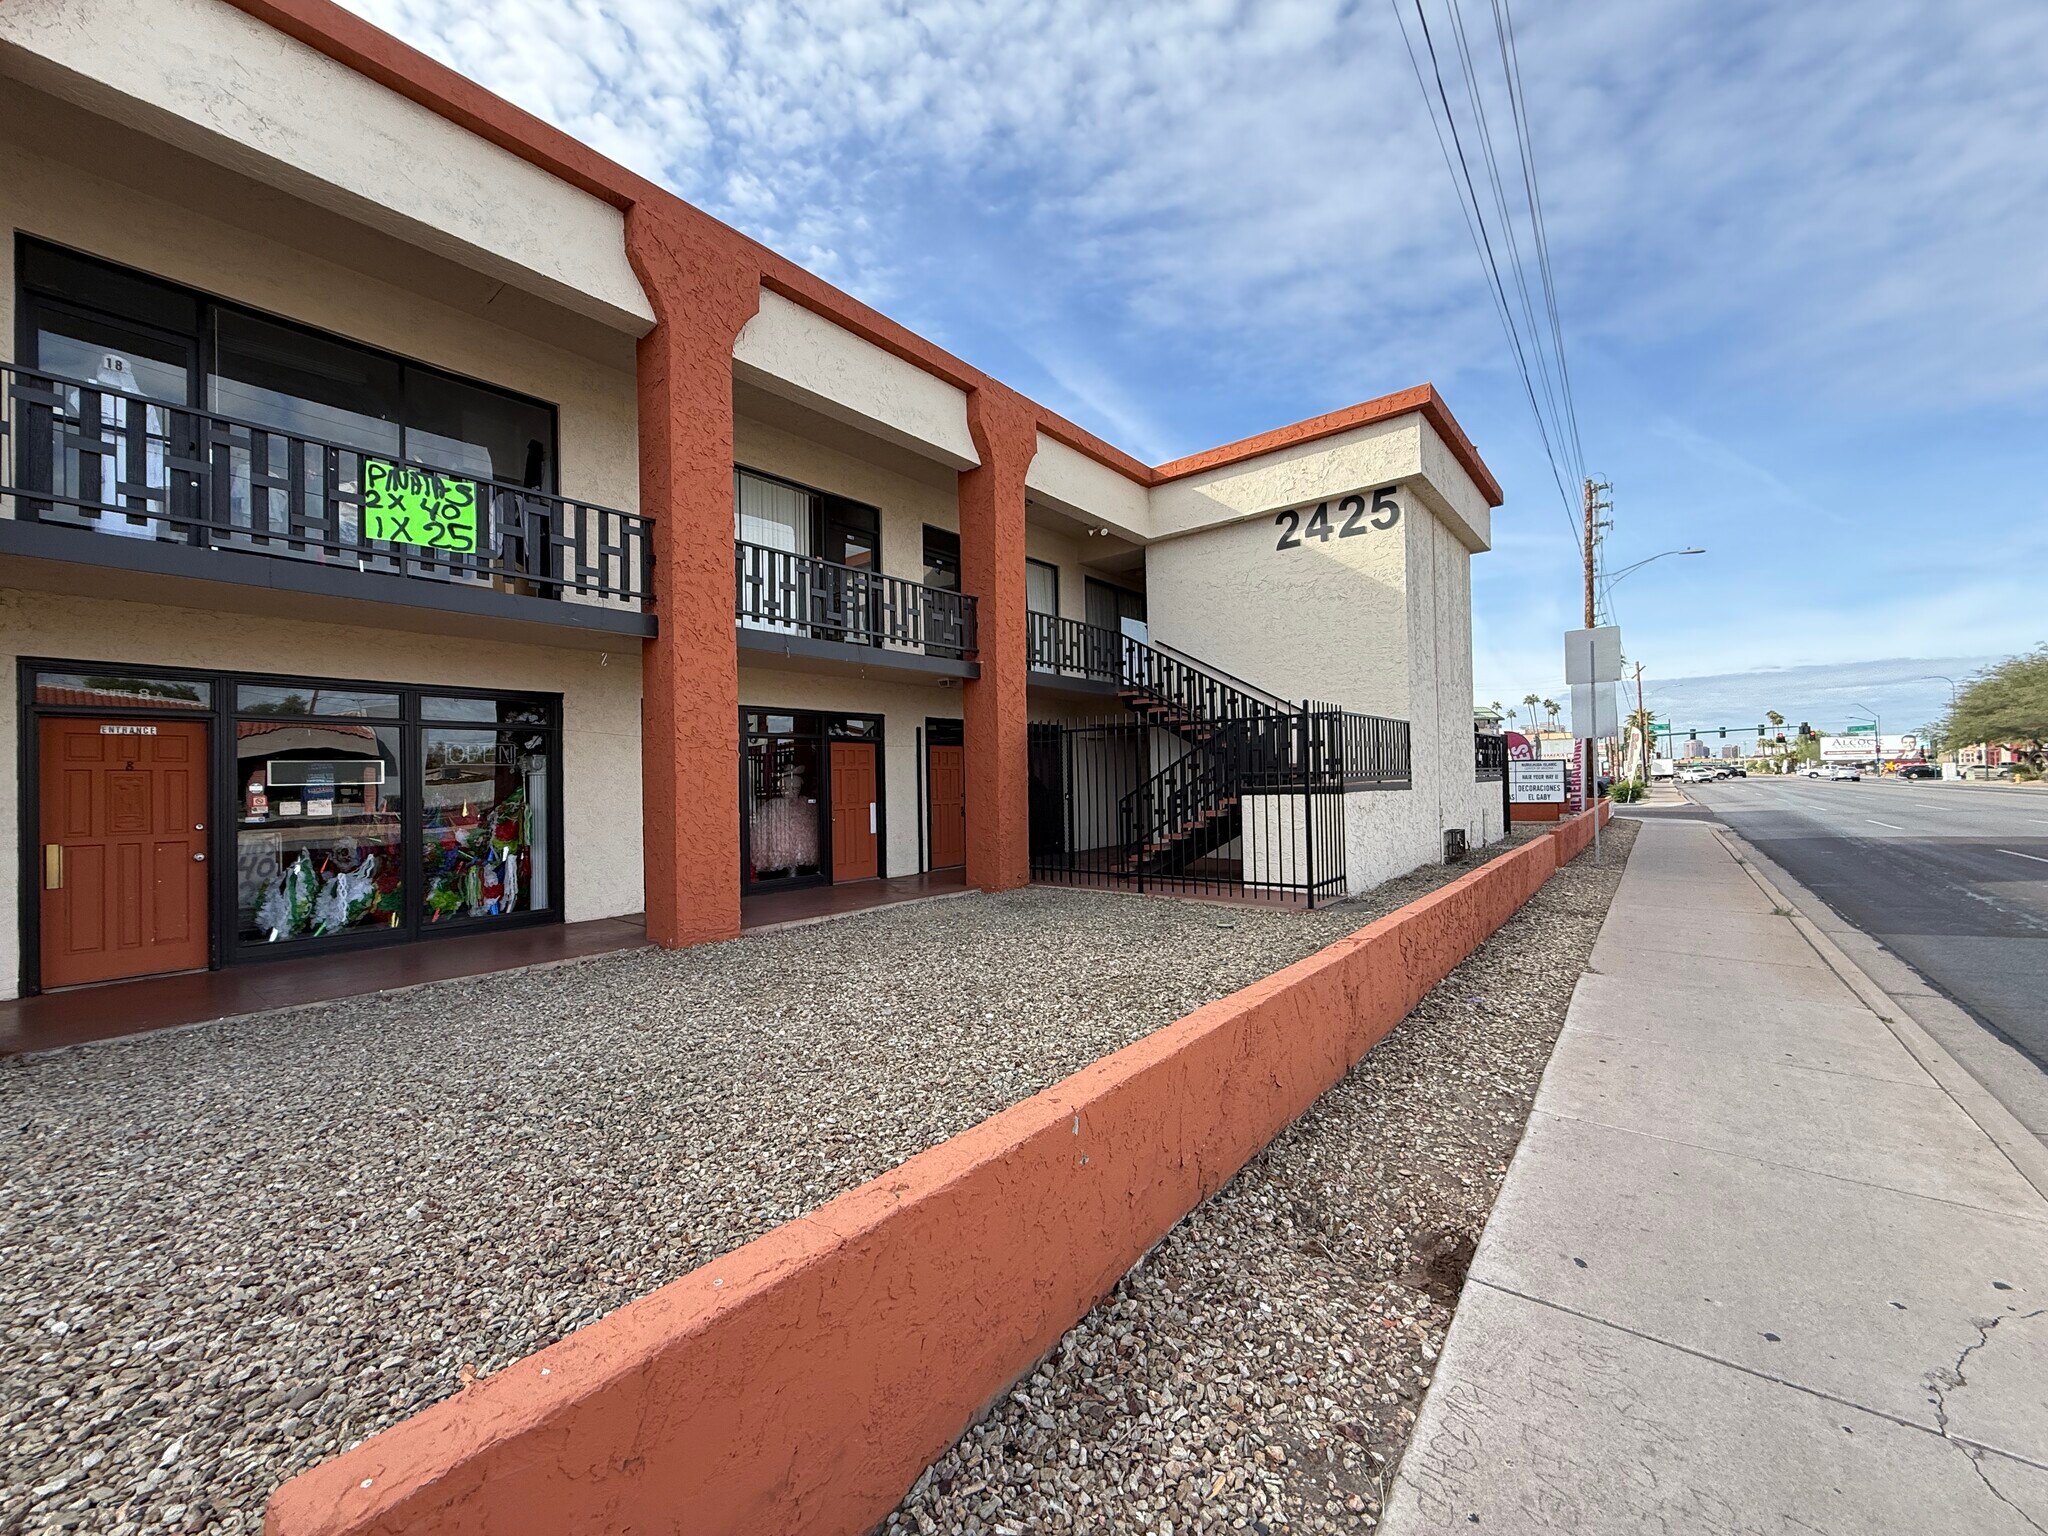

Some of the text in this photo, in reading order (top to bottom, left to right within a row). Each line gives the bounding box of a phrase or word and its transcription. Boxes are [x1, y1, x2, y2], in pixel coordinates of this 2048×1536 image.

[106, 358, 122, 371] 18
[420, 498, 461, 522] 40
[1275, 486, 1401, 551] 2425
[375, 516, 382, 538] 1
[423, 522, 473, 551] 25
[94, 687, 132, 698] SUITE
[138, 688, 150, 699] 8
[102, 726, 156, 735] ENTRANCE
[449, 743, 513, 763] OPEN
[1518, 784, 1561, 792] DECORACIONES
